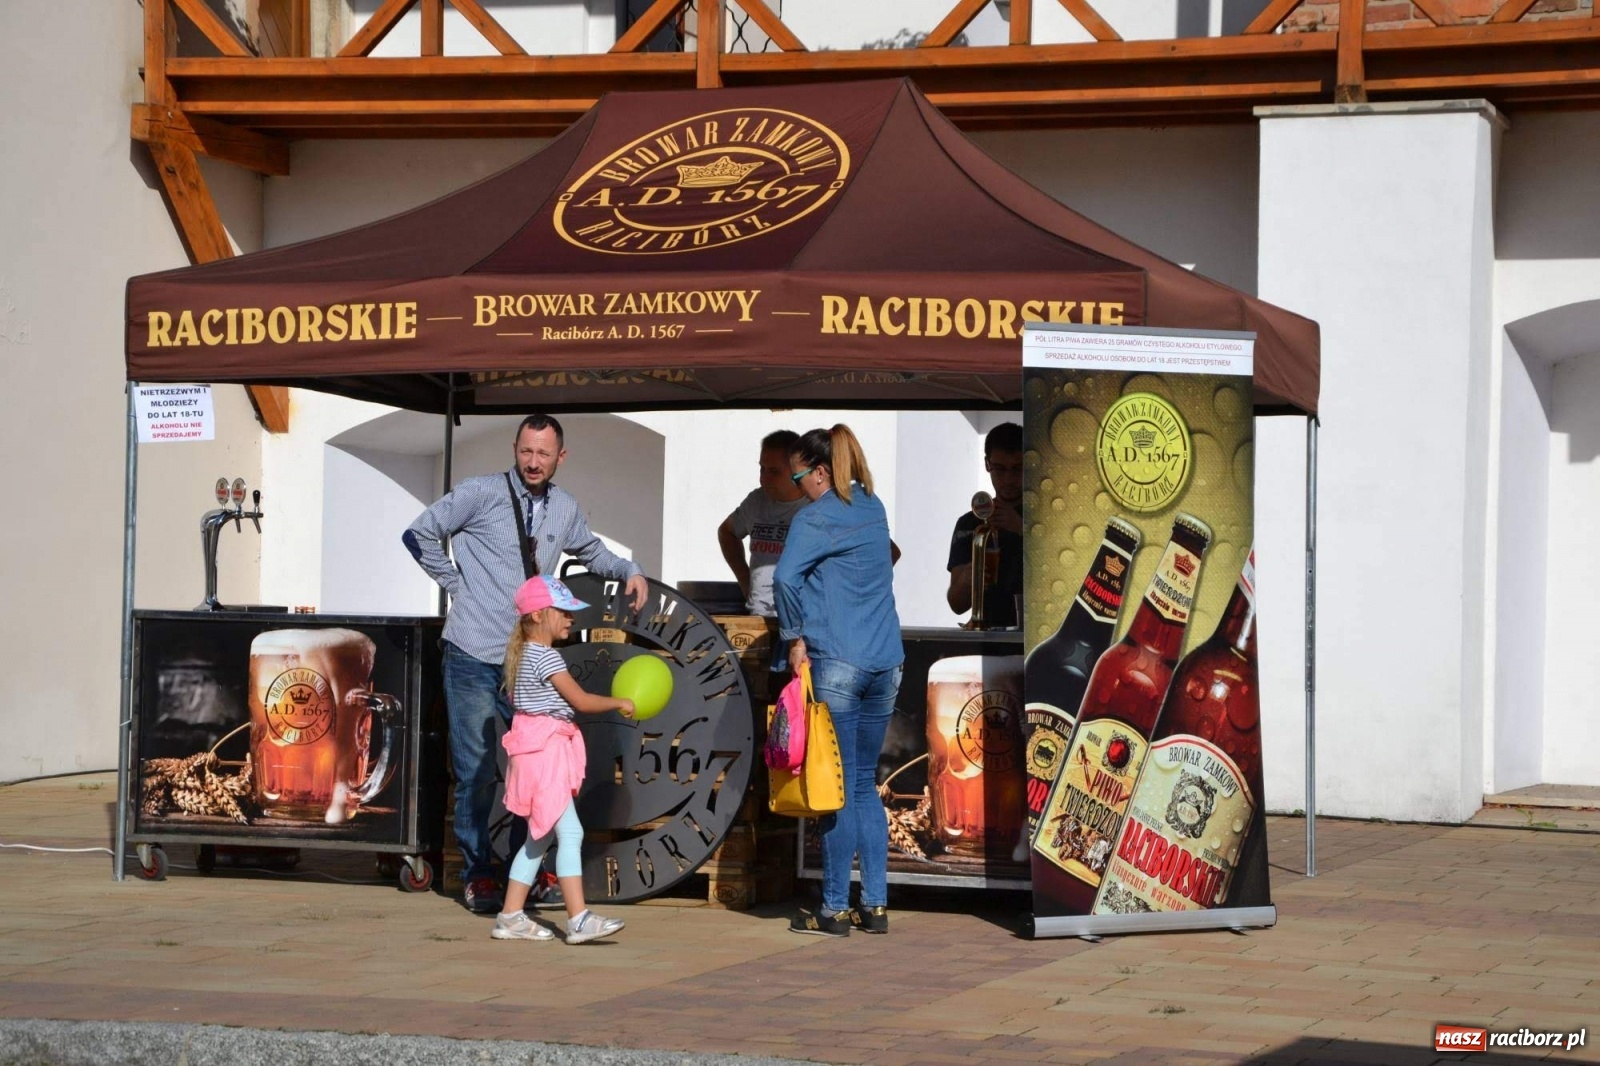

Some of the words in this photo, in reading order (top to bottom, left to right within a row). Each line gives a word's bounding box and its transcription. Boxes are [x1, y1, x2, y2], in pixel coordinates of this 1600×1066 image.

[598, 119, 720, 183] BROWAR
[728, 116, 838, 172] ZAMKOWY
[701, 172, 821, 209] 1567
[574, 214, 772, 250] RACIBÓRZ
[473, 294, 597, 326] BROWAR
[603, 289, 761, 322] ZAMKOWY
[147, 302, 417, 347] RACIBORSKIE
[541, 325, 604, 340] Racibórz
[649, 324, 686, 339] 1567
[1048, 336, 1064, 344] LITRA
[1066, 337, 1081, 345] PIWA
[1081, 337, 1108, 346] ZAWIERA
[1108, 338, 1115, 346] 25
[1116, 338, 1142, 347] GRAMÓW
[1143, 340, 1175, 348] CZYSTEGO
[1207, 343, 1243, 351] ETYLOWEGO
[1045, 352, 1077, 360] SPRZEDAŻ
[1077, 354, 1109, 362] ALKOHOLU
[1110, 355, 1136, 363] OSOBOM
[1166, 357, 1181, 365] JEST
[1181, 358, 1231, 367] PRZESTĘPSTWEM
[150, 399, 199, 407] MŁODZIEŻY
[180, 410, 204, 418] 18-TU
[150, 422, 189, 430] ALKOHOLU
[152, 431, 202, 439] SPRZEDAJEMY
[1147, 442, 1180, 471] 1567
[302, 701, 330, 723] 1567
[1027, 713, 1053, 726] BROWAR
[611, 716, 742, 816] 1567
[1169, 746, 1202, 767] BROWAR
[1202, 756, 1240, 798] ZAMKOWY
[1090, 768, 1123, 807] PIWO
[1117, 816, 1226, 909] RACIBORSKIE
